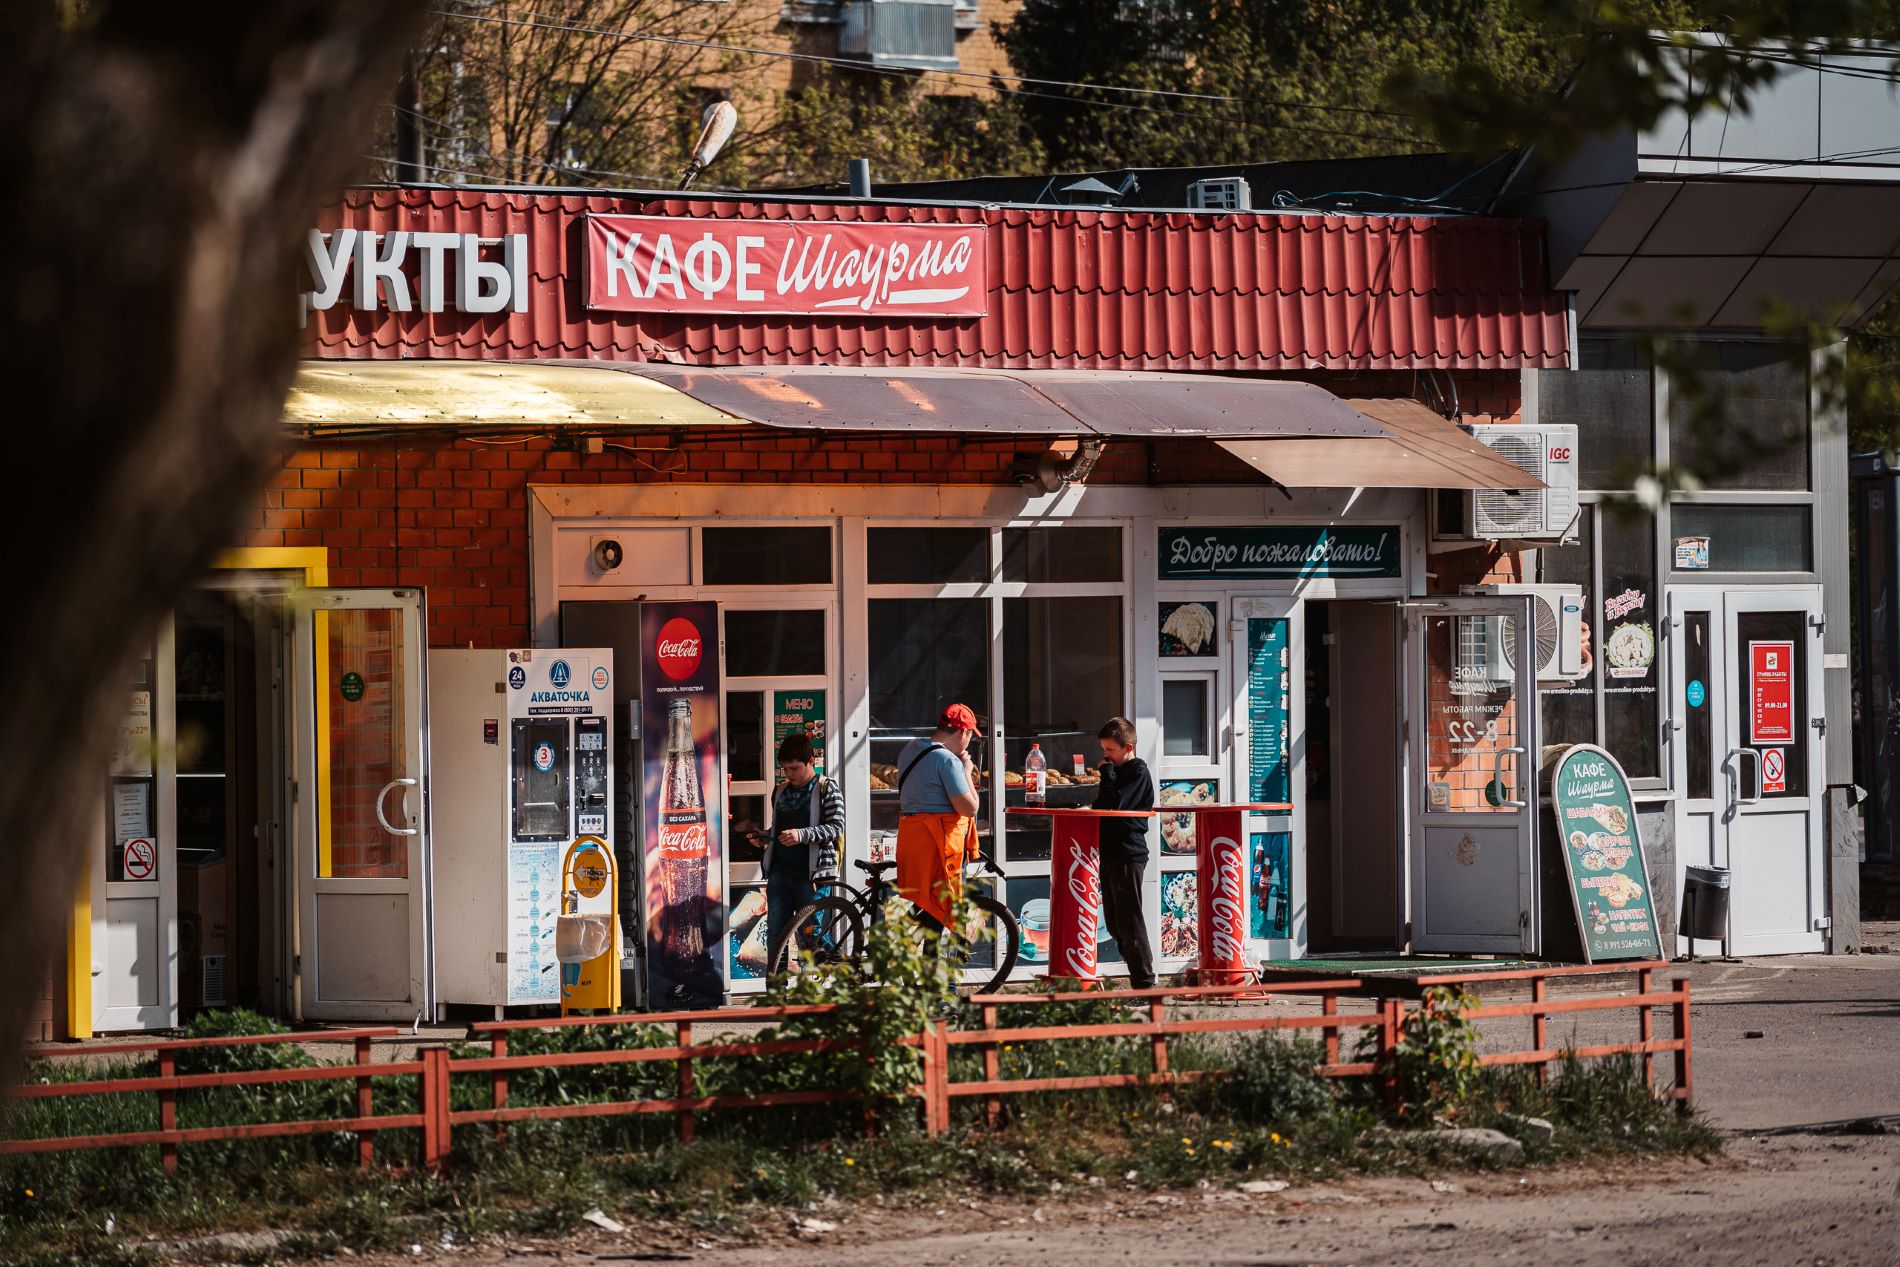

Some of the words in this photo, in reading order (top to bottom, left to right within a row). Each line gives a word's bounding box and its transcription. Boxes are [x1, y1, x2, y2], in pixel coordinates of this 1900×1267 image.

[302, 228, 528, 313] УКТЫ
[606, 231, 765, 301] КАФЕ
[775, 232, 973, 311] Шаурма
[1549, 447, 1570, 460] IGC
[1170, 535, 1238, 572] Добро
[1242, 532, 1388, 563] пожаловать!
[658, 638, 701, 658] Coca-Cola
[511, 670, 523, 681] 24
[530, 690, 590, 703] АКВАТОЧКА
[785, 698, 814, 710] МЕНЮ
[540, 748, 548, 760] 3
[1573, 762, 1607, 778] КАФЕ
[1567, 778, 1616, 799] Шаурма
[659, 825, 706, 851] Coca-Cola
[1065, 837, 1100, 979] Coca-Cola
[1210, 836, 1247, 968] Coca-Cola
[1608, 908, 1647, 921] НАПИТКИ
